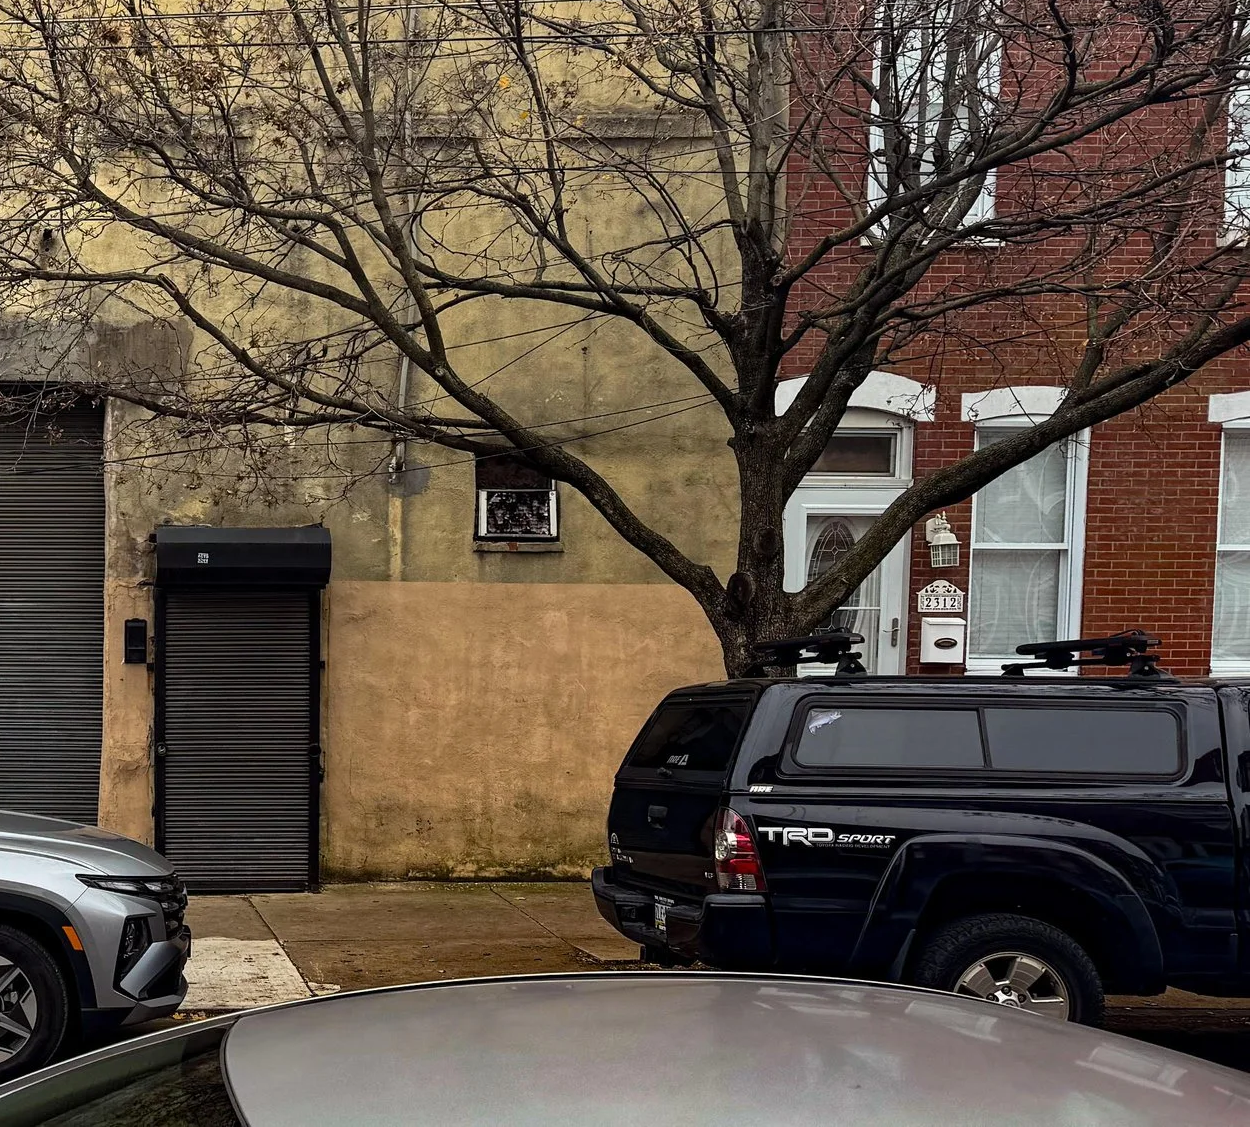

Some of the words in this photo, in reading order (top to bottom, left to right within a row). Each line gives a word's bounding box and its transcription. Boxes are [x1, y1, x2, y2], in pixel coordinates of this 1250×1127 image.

[925, 597, 956, 608] 2312
[757, 827, 835, 846] TRD
[836, 834, 896, 844] SPORT
